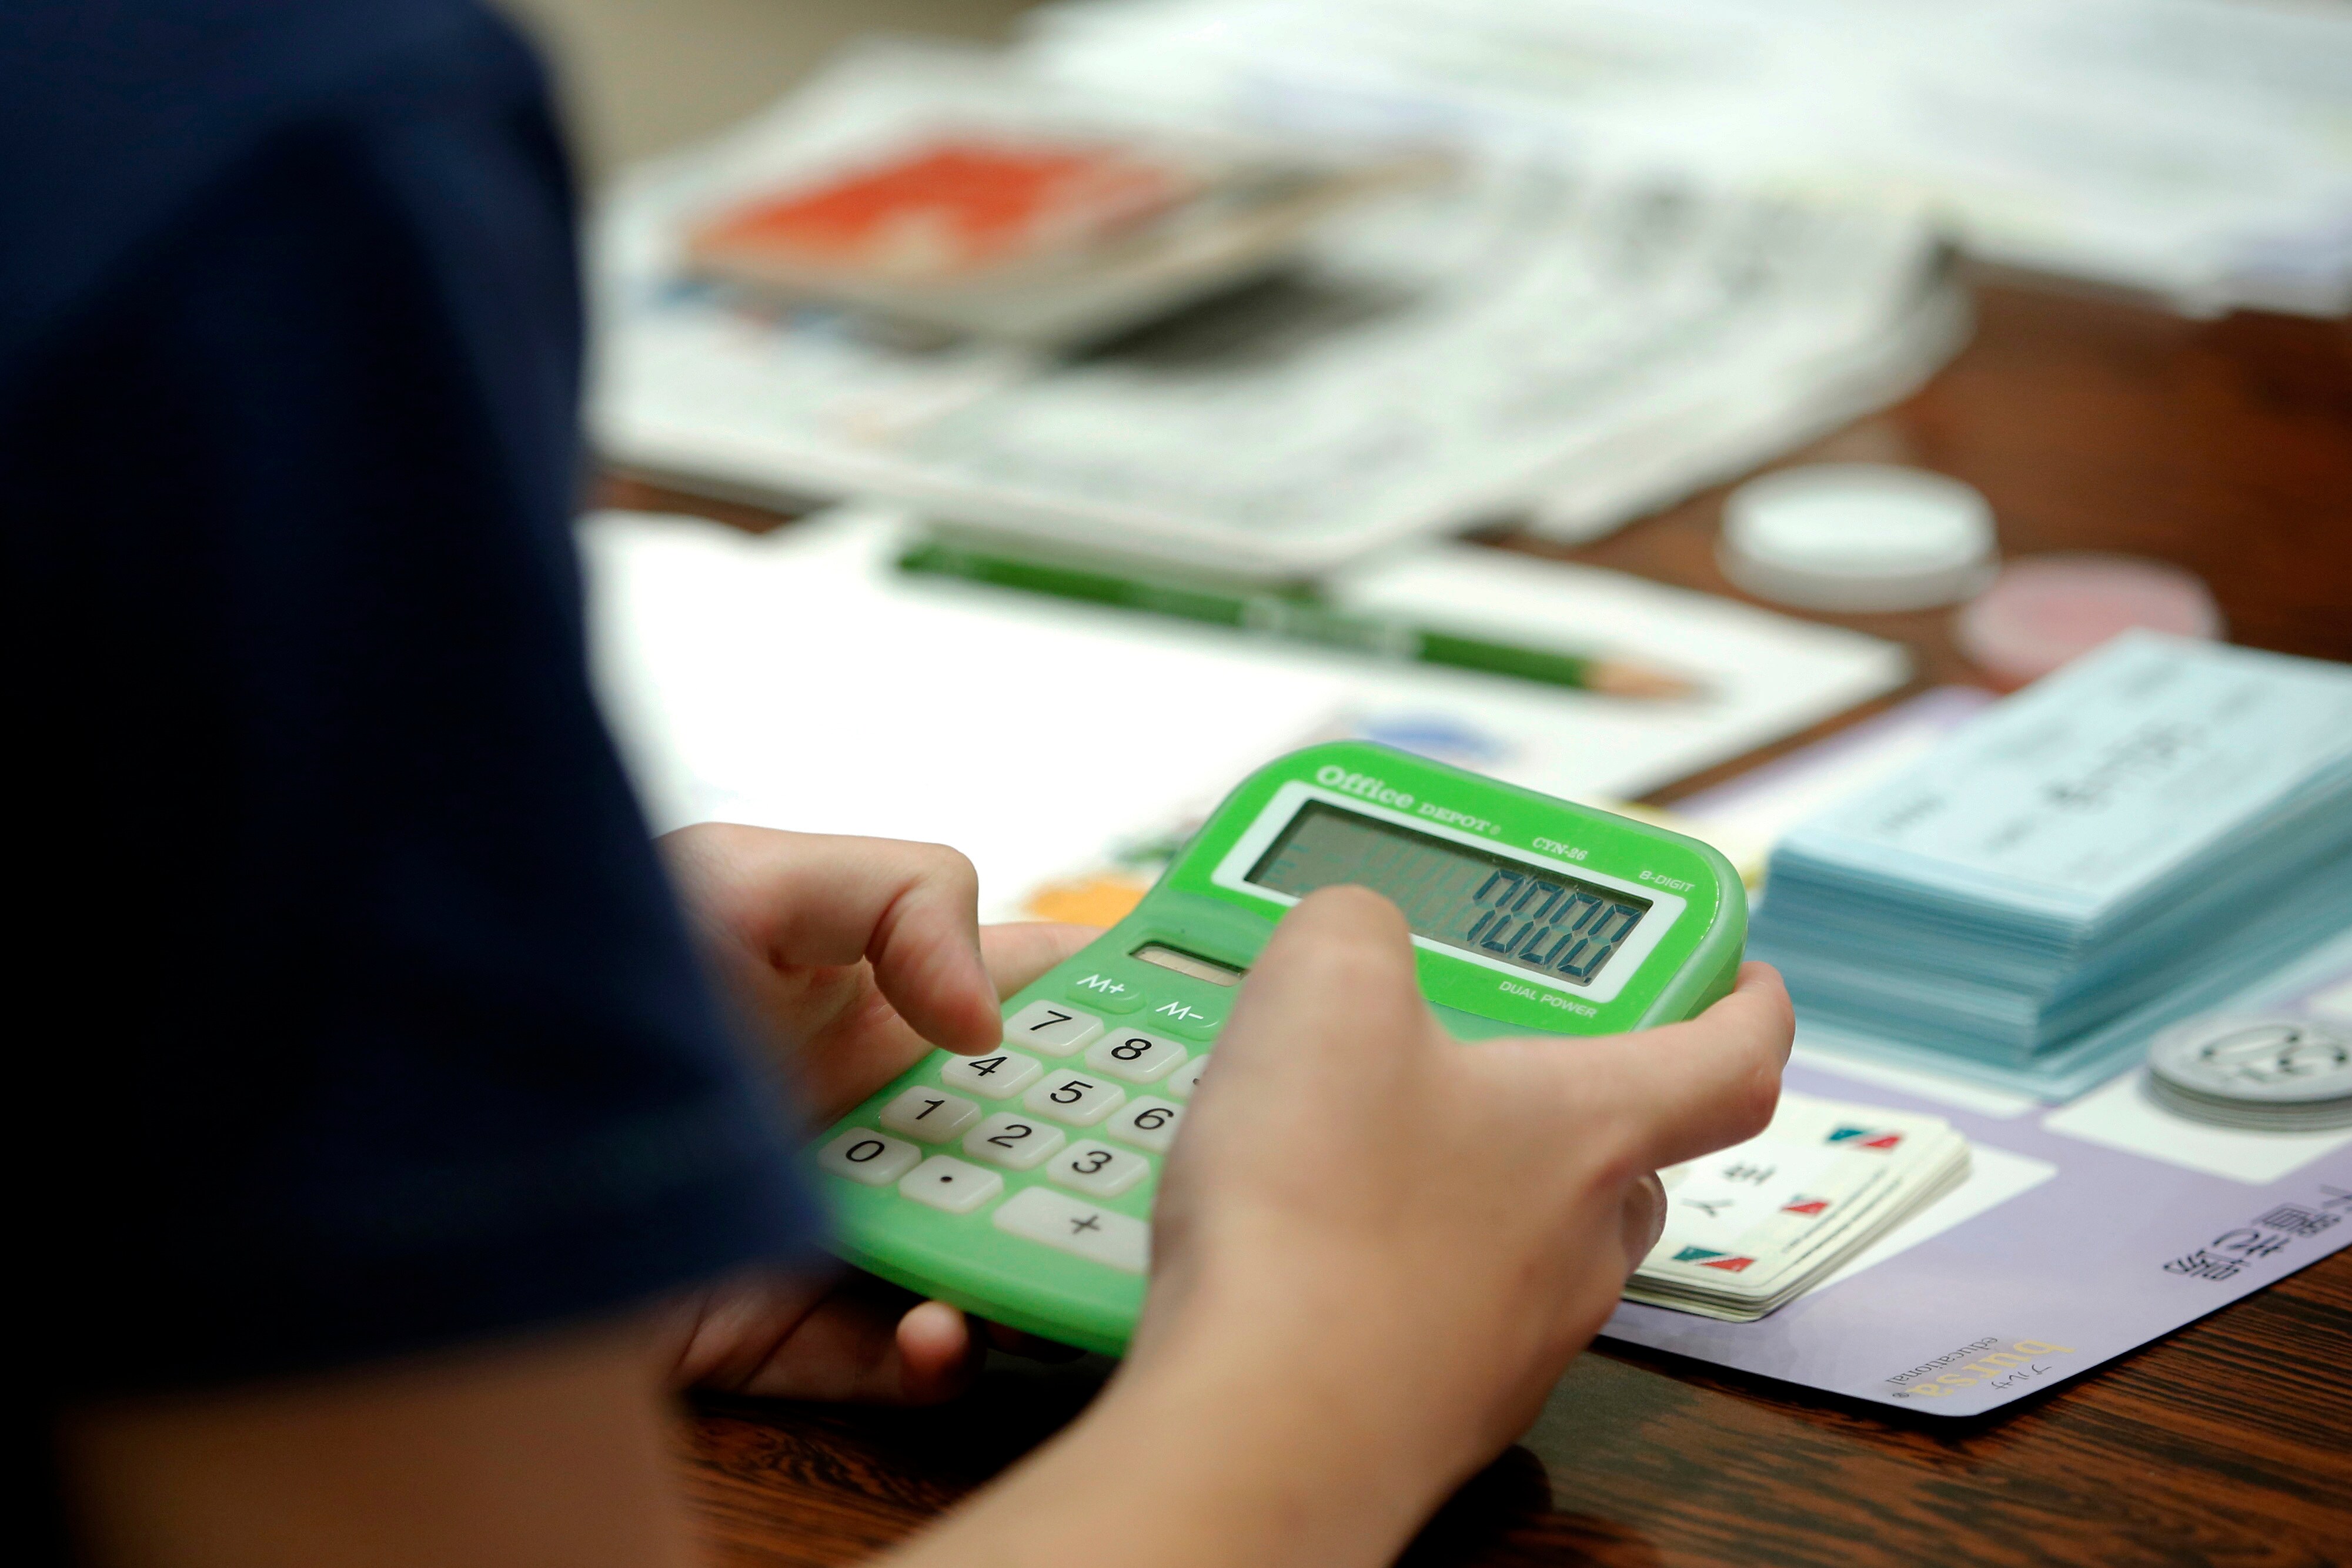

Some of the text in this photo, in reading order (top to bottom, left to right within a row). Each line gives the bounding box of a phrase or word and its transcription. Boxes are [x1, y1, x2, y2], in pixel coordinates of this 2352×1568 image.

[1316, 765, 1491, 832] Office DEPOT
[1532, 837, 1588, 861] CYN-26
[1077, 974, 1204, 1020] M+ M-
[1499, 981, 1598, 1018] DUAL POWER
[1030, 1010, 1152, 1061] 7 8
[968, 1055, 1174, 1131] 4 5 6
[846, 1139, 885, 1164] 0
[914, 1099, 1112, 1174] 1 2 3
[1885, 1337, 1998, 1386] educational
[1905, 1339, 2077, 1398] bursa
